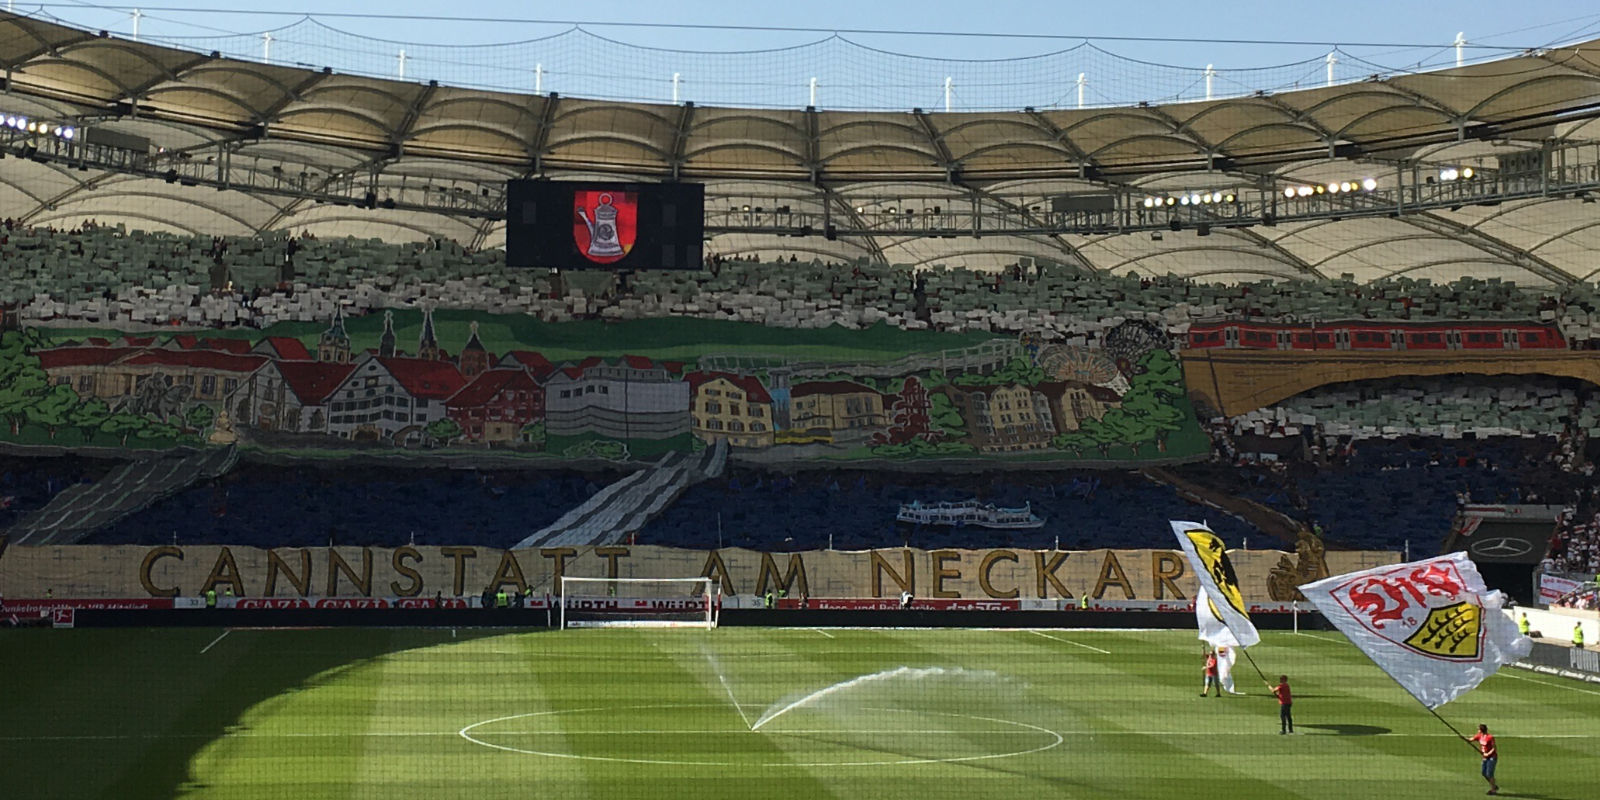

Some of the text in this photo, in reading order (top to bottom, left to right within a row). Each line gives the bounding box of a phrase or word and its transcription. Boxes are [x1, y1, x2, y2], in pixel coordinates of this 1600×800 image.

[139, 547, 1187, 600] CANNSTATT AM NECKAR
[243, 599, 301, 609] GAZI
[322, 600, 382, 609] GAZI
[1401, 615, 1419, 629] 18
